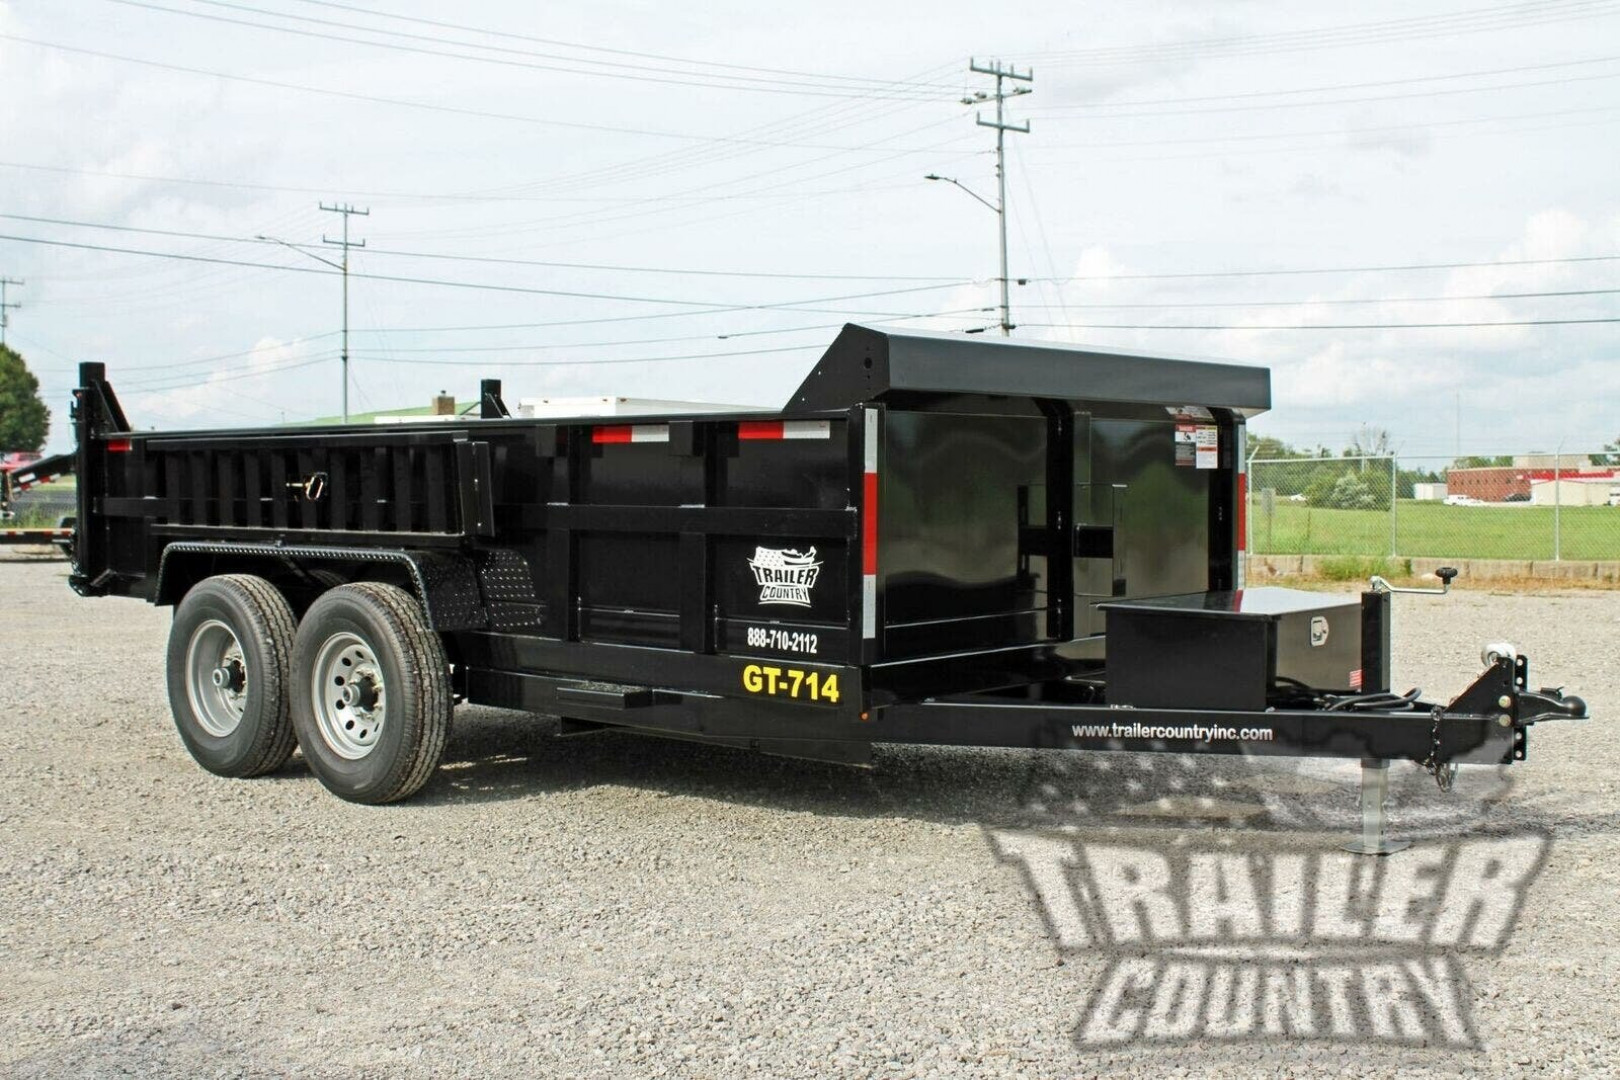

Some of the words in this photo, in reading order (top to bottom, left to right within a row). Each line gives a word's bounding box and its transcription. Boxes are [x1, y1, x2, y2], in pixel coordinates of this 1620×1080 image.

[753, 566, 818, 585] TRAILER
[761, 586, 810, 602] COUNTRY
[747, 627, 818, 654] 888-710-2112
[742, 664, 840, 703] GT-714
[1072, 723, 1273, 742] www.trailercountryinc.com
